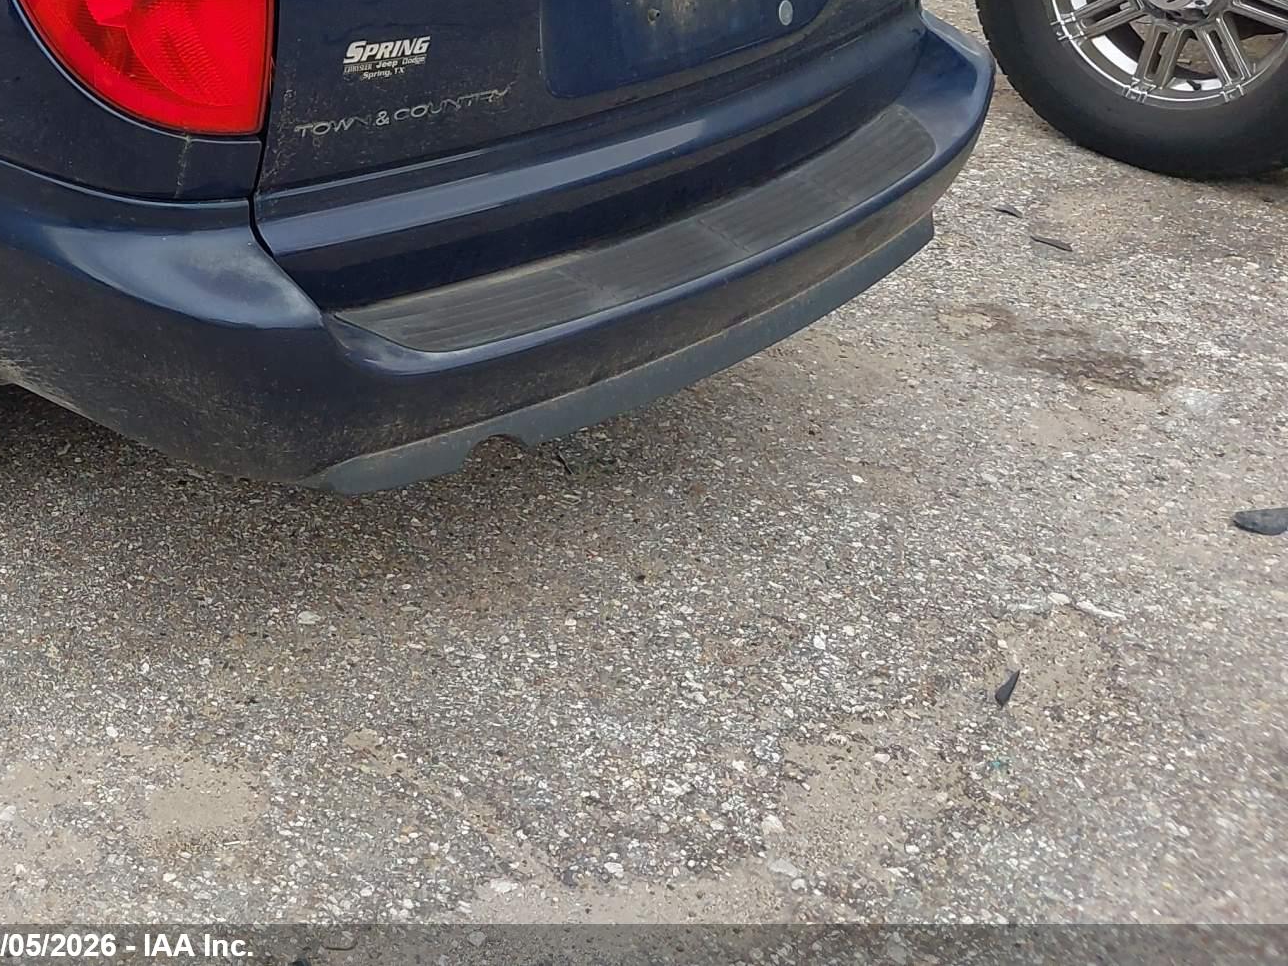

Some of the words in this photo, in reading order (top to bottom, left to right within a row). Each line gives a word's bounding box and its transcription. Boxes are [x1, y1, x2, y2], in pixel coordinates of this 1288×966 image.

[375, 58, 398, 70] Jeep
[402, 55, 426, 65] Dodge
[362, 70, 393, 80] Spring,
[395, 66, 406, 75] TX
[294, 114, 372, 138] TOWN
[375, 111, 390, 126] &
[394, 81, 516, 121] COUNTRY
